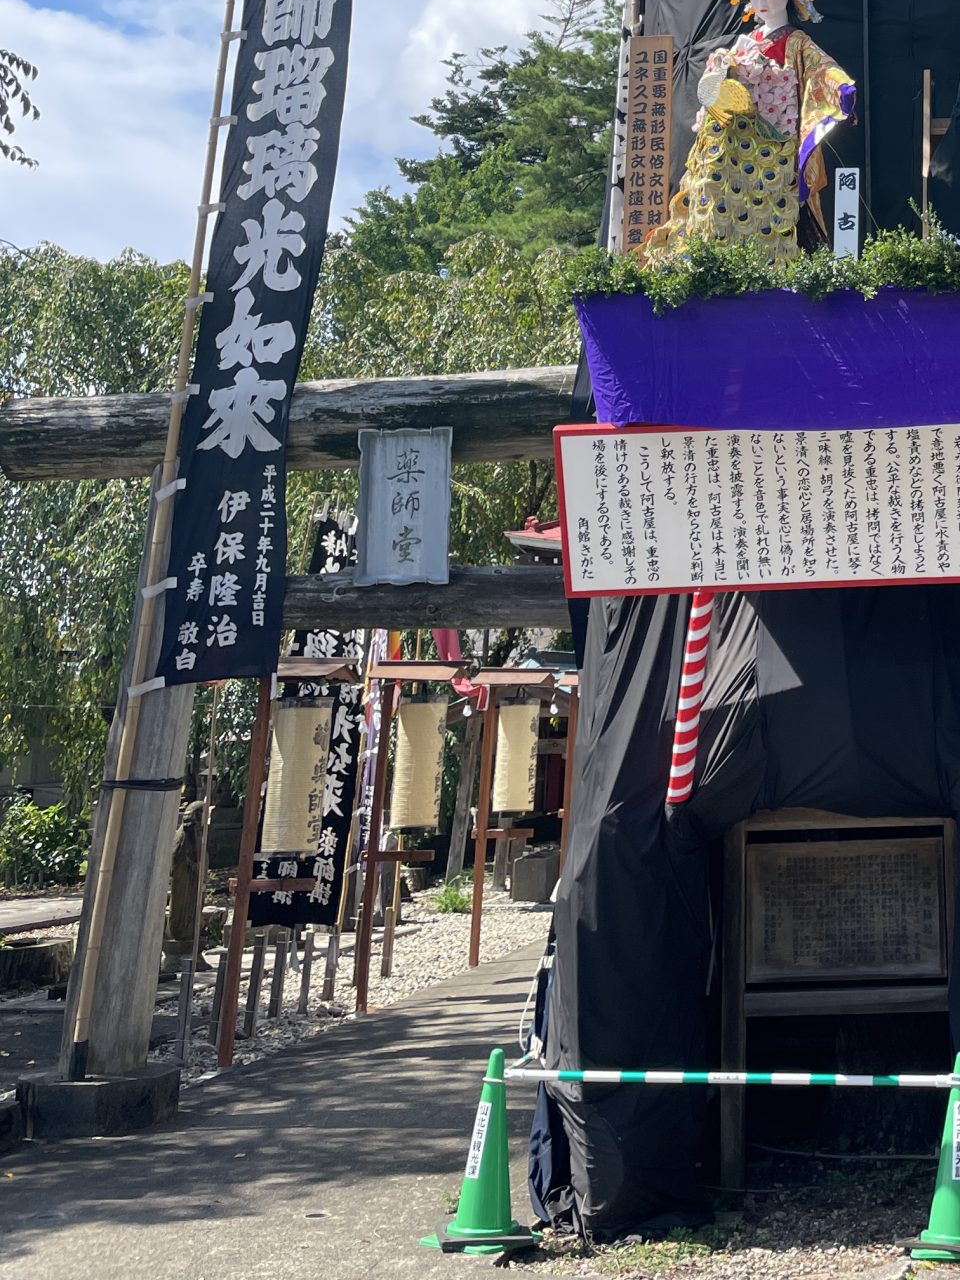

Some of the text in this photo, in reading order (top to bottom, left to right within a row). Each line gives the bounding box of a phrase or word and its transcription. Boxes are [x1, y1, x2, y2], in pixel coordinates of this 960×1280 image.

[627, 50, 649, 252] ユネスコ無形文化遺産登
[838, 172, 857, 259] 阿古
[661, 437, 677, 506] し釈放する。
[206, 490, 251, 648] 伊保隆治
[251, 464, 277, 627] 平成二十年九月吉日
[577, 517, 594, 580] 角館きがた
[175, 551, 207, 671] 卒寿 敬白
